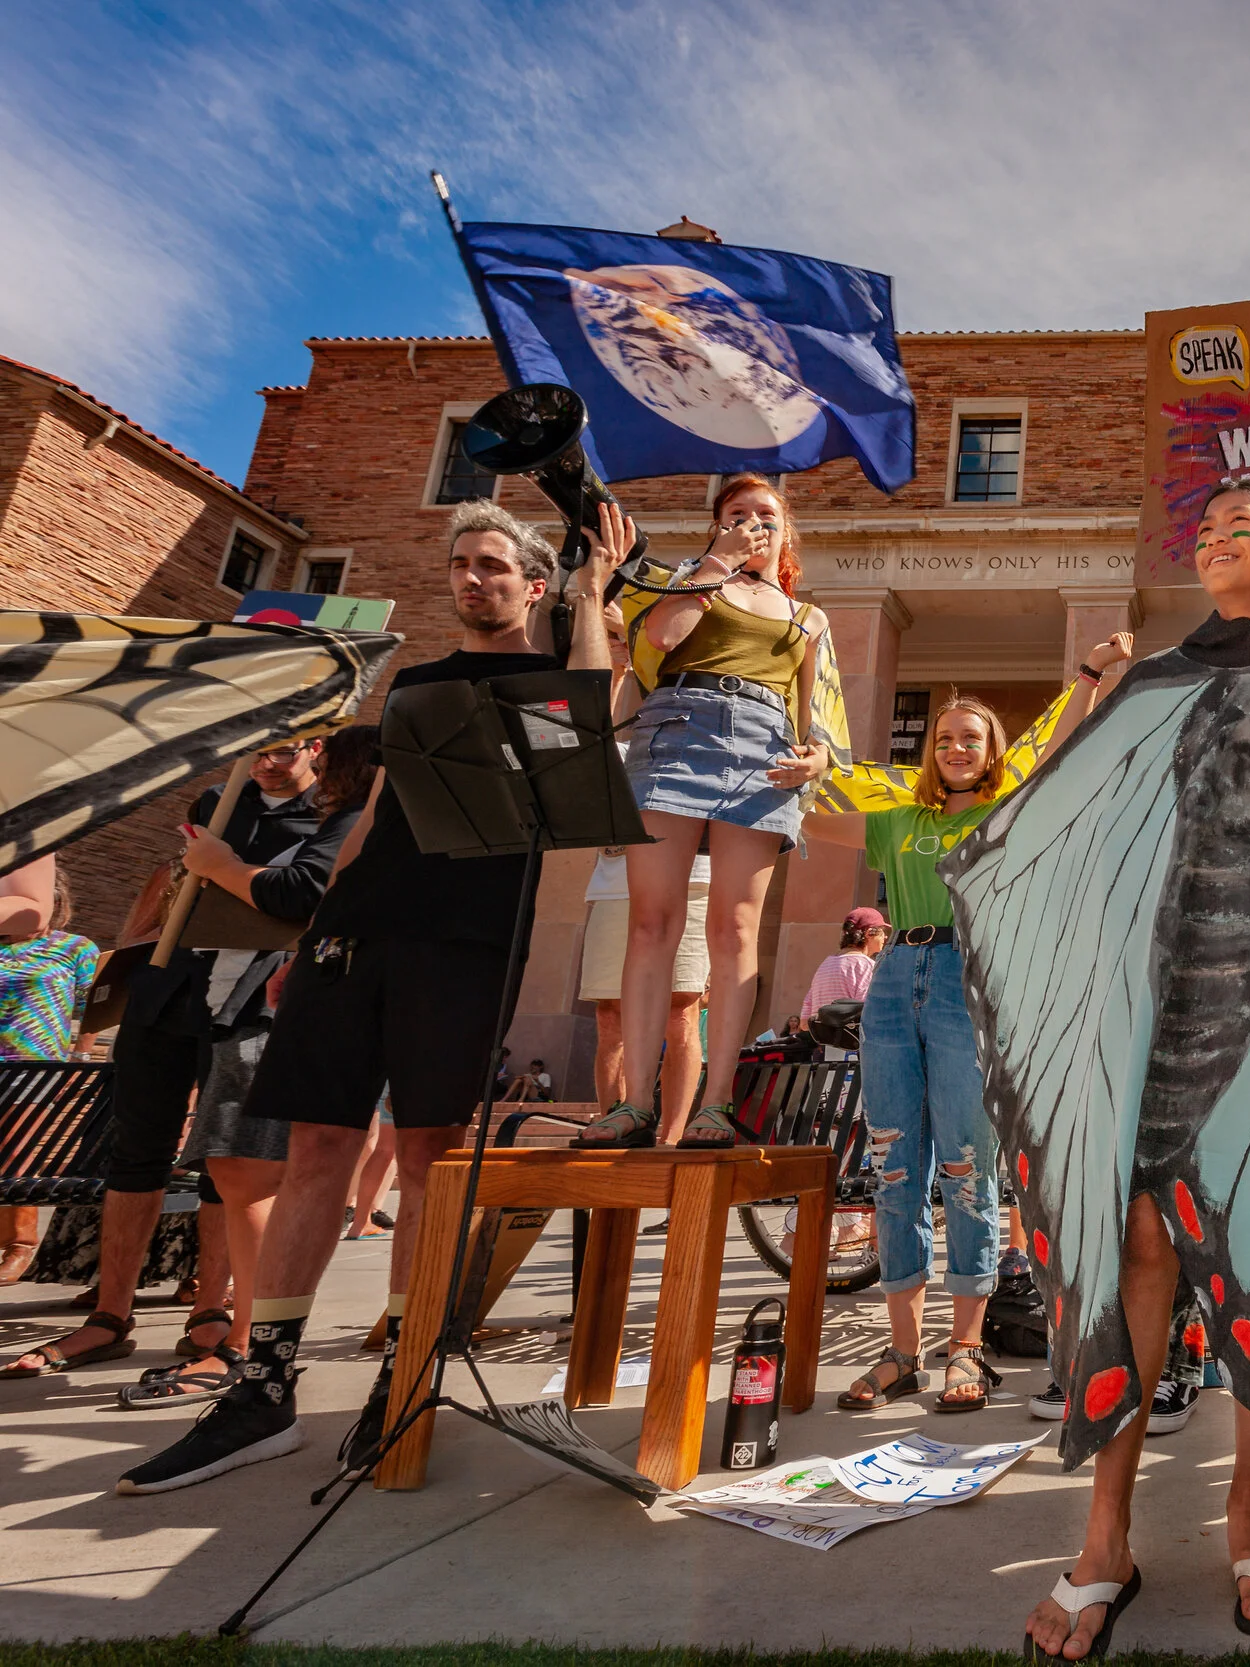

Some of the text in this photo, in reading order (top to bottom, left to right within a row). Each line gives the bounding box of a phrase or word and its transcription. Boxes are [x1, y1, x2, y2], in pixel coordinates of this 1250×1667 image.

[1180, 335, 1243, 375] SPEAK
[836, 555, 1135, 570] WHO KNOWS ONLY HIS OW
[738, 1451, 749, 1459] 22
[839, 1453, 902, 1498] ACT
[779, 1522, 848, 1546] MORE
